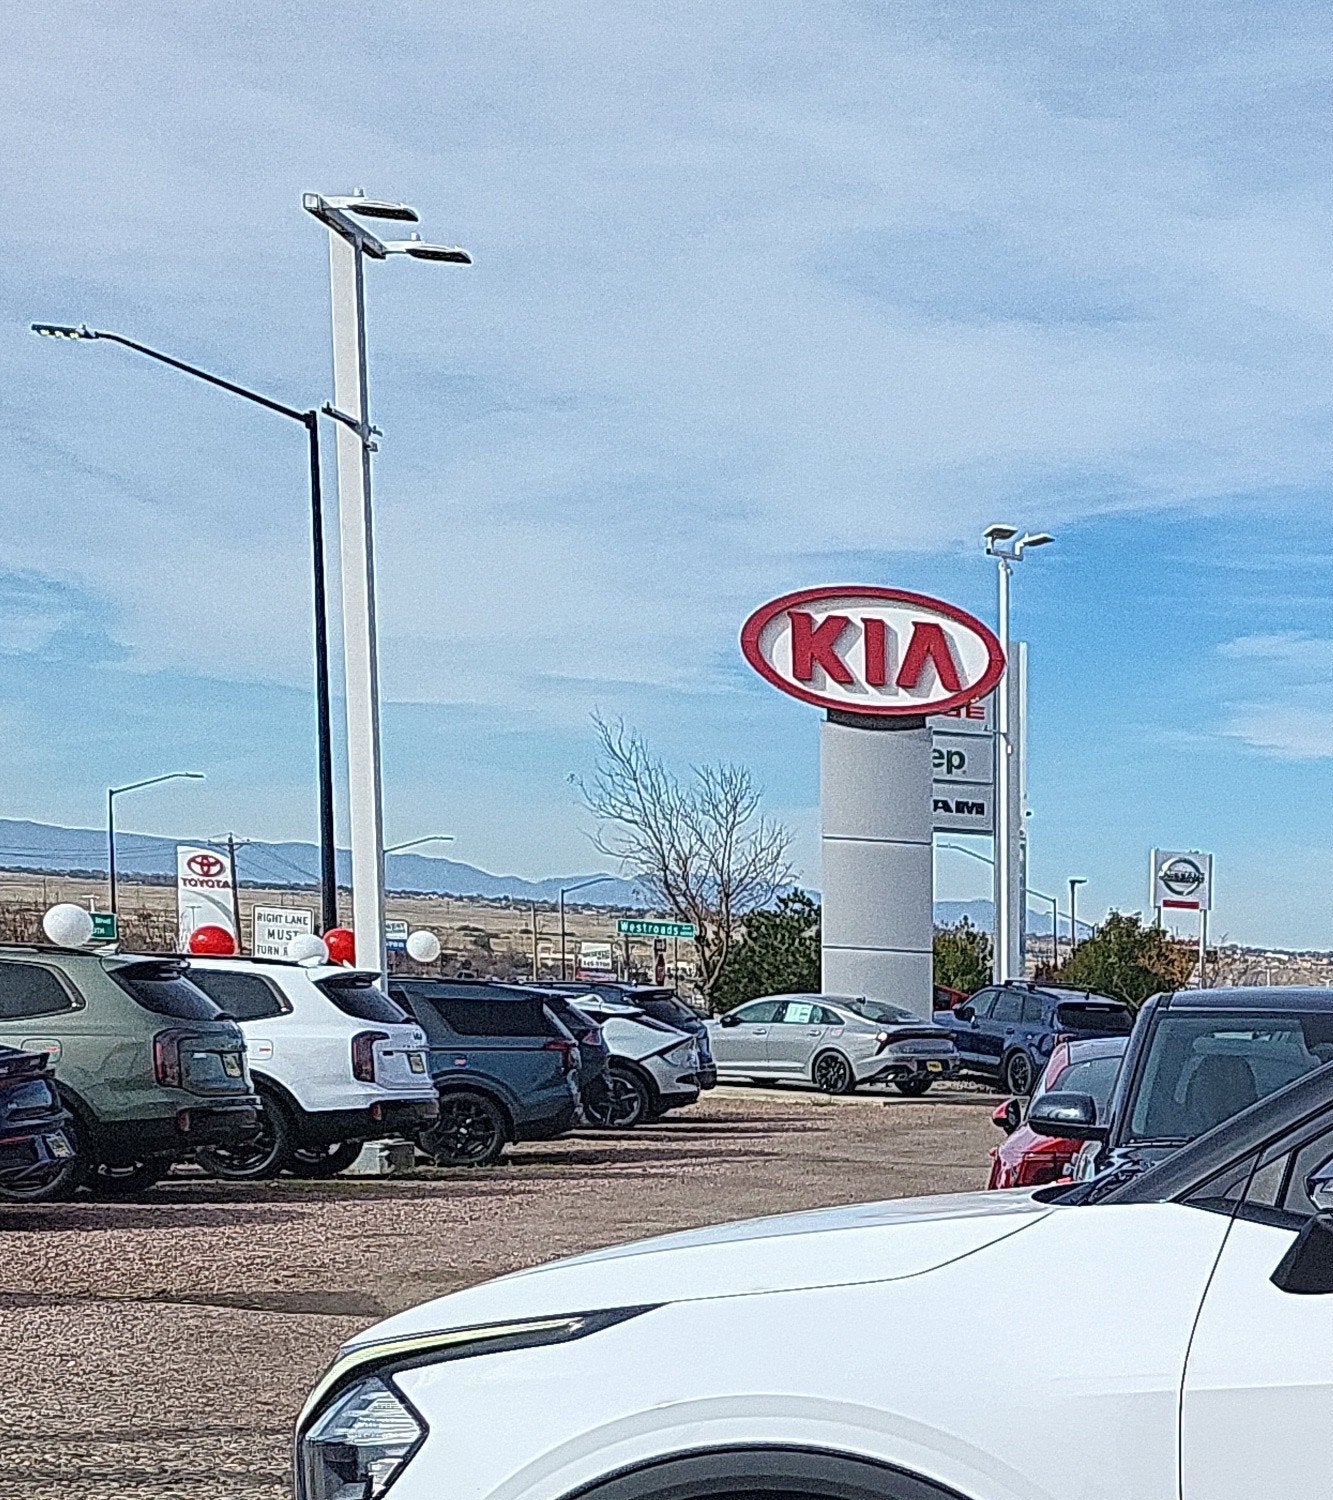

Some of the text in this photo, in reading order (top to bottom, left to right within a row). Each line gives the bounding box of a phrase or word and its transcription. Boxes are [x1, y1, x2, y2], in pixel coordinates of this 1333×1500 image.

[787, 610, 962, 692] KIA
[933, 799, 985, 816] AM
[181, 877, 231, 889] TOYOTA
[257, 912, 308, 925] RIGHT LANE
[267, 929, 298, 941] MUST
[620, 921, 679, 936] Westroads
[257, 944, 280, 956] TURN
